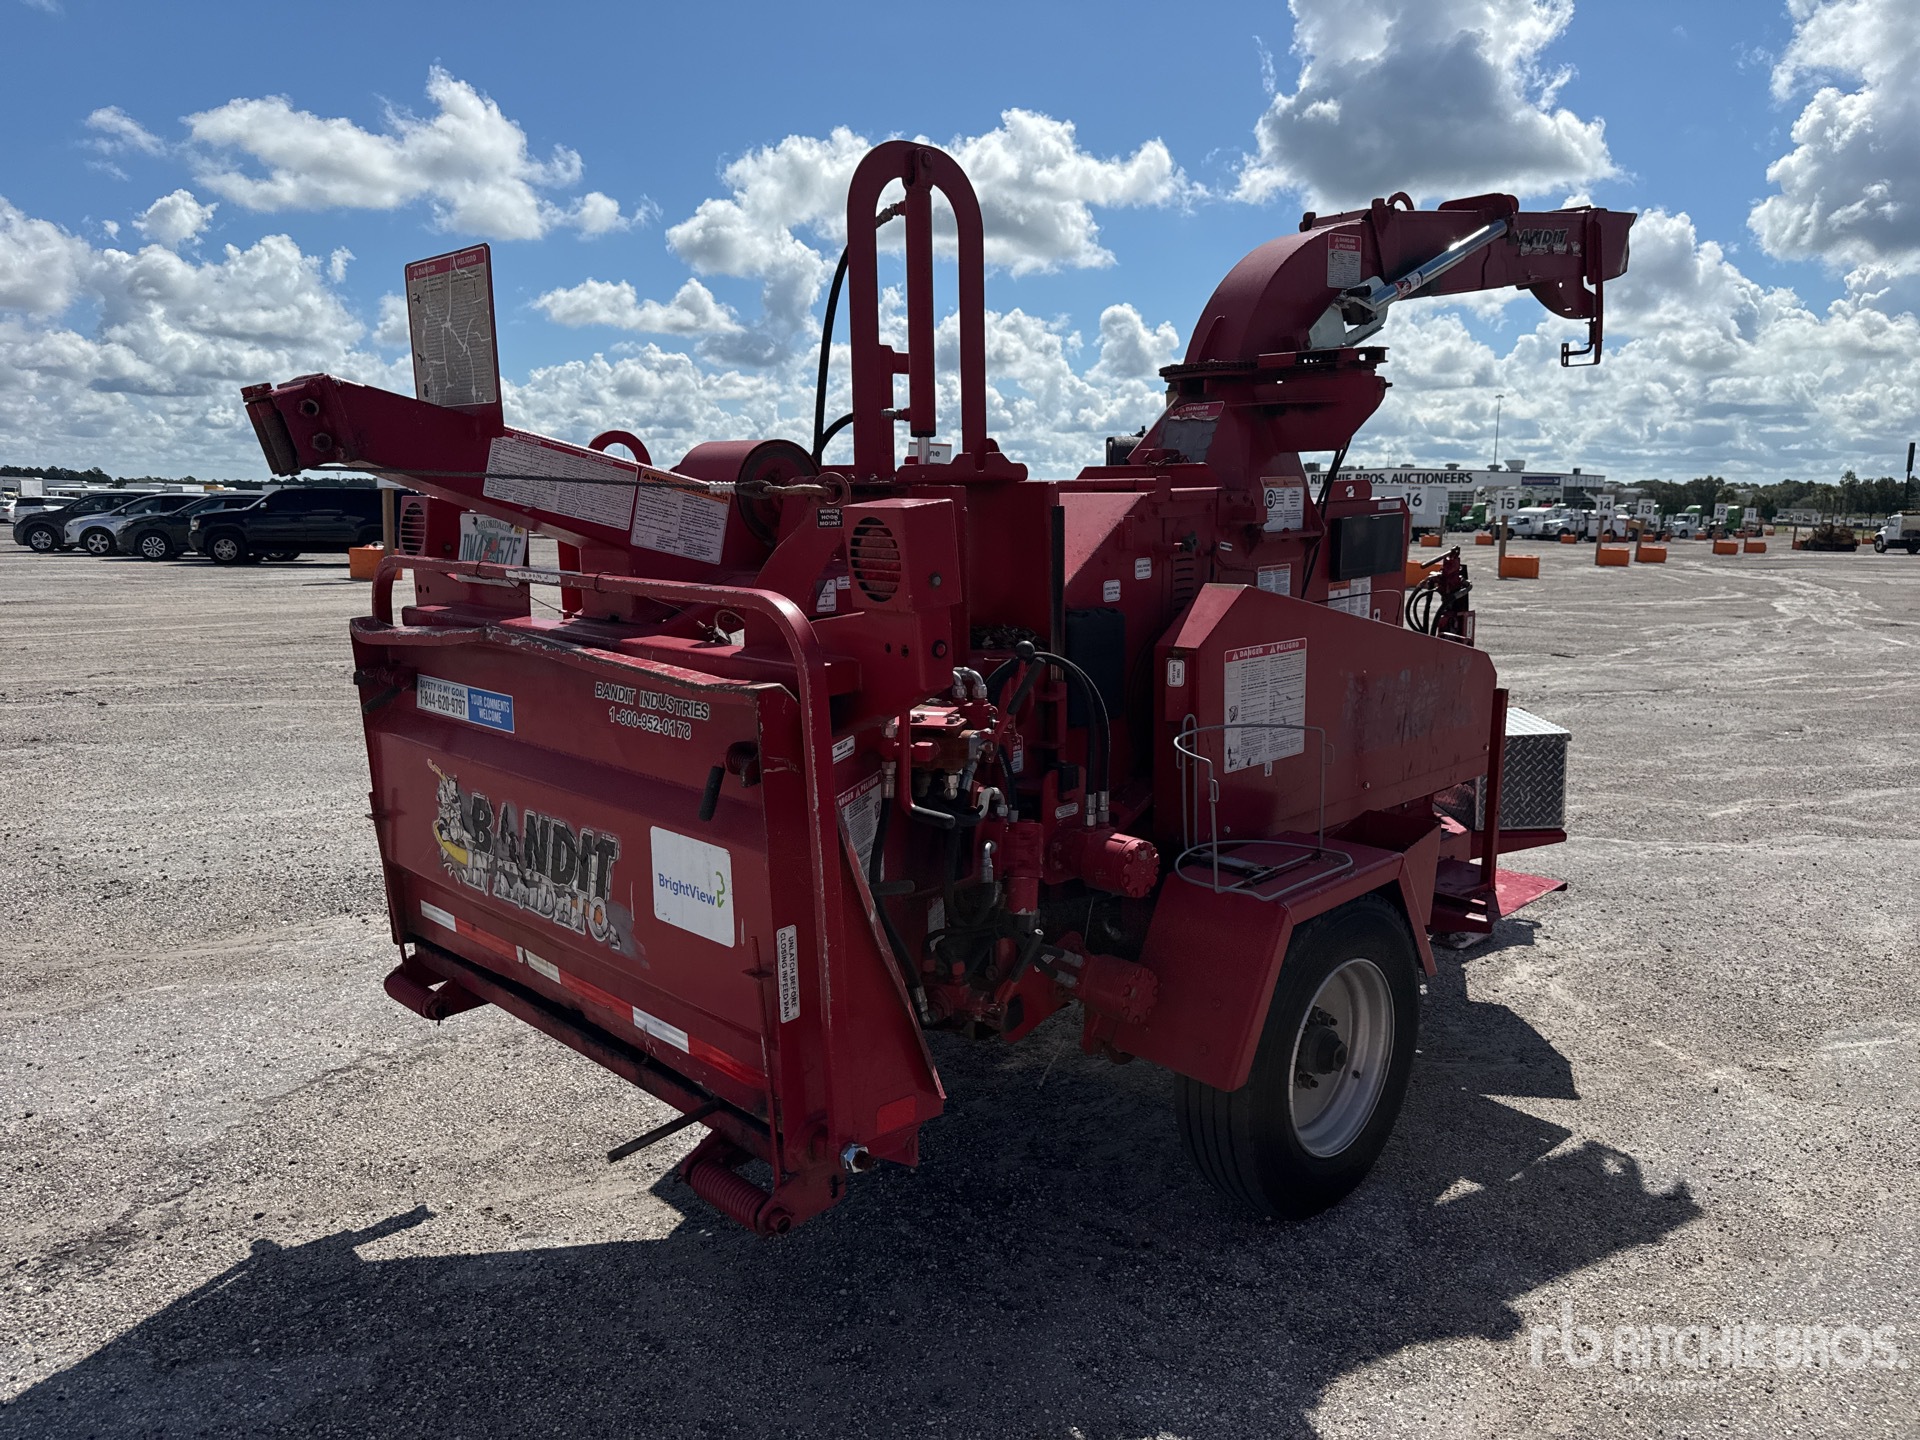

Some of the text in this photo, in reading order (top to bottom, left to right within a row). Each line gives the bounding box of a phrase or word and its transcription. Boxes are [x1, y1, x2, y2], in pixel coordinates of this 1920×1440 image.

[457, 254, 477, 266] PELIGRO
[520, 436, 541, 446] DANGER
[1391, 472, 1472, 484] AUCTIONEERS
[1405, 492, 1422, 507] 16
[1500, 497, 1515, 509] 15
[1599, 501, 1611, 511] 14
[1640, 504, 1652, 514] 13
[1716, 508, 1726, 516] 12
[1239, 641, 1300, 659] DANGER PELIGRO
[420, 680, 465, 699] SAFETY IS MY GOAL
[420, 690, 466, 716] 1-844-620-9797
[470, 693, 510, 713] YOUR COMMENTS
[595, 681, 710, 721] BANDIT INDUSTRIES
[478, 707, 502, 724] WELCOME
[608, 706, 692, 740] 1-800-952-0178
[861, 775, 879, 793] PELIGRO
[471, 792, 621, 901] BANDIT
[657, 872, 716, 906] BrightView
[780, 932, 788, 969] CLOSING
[788, 936, 798, 1009] UNLATCH BEFORE
